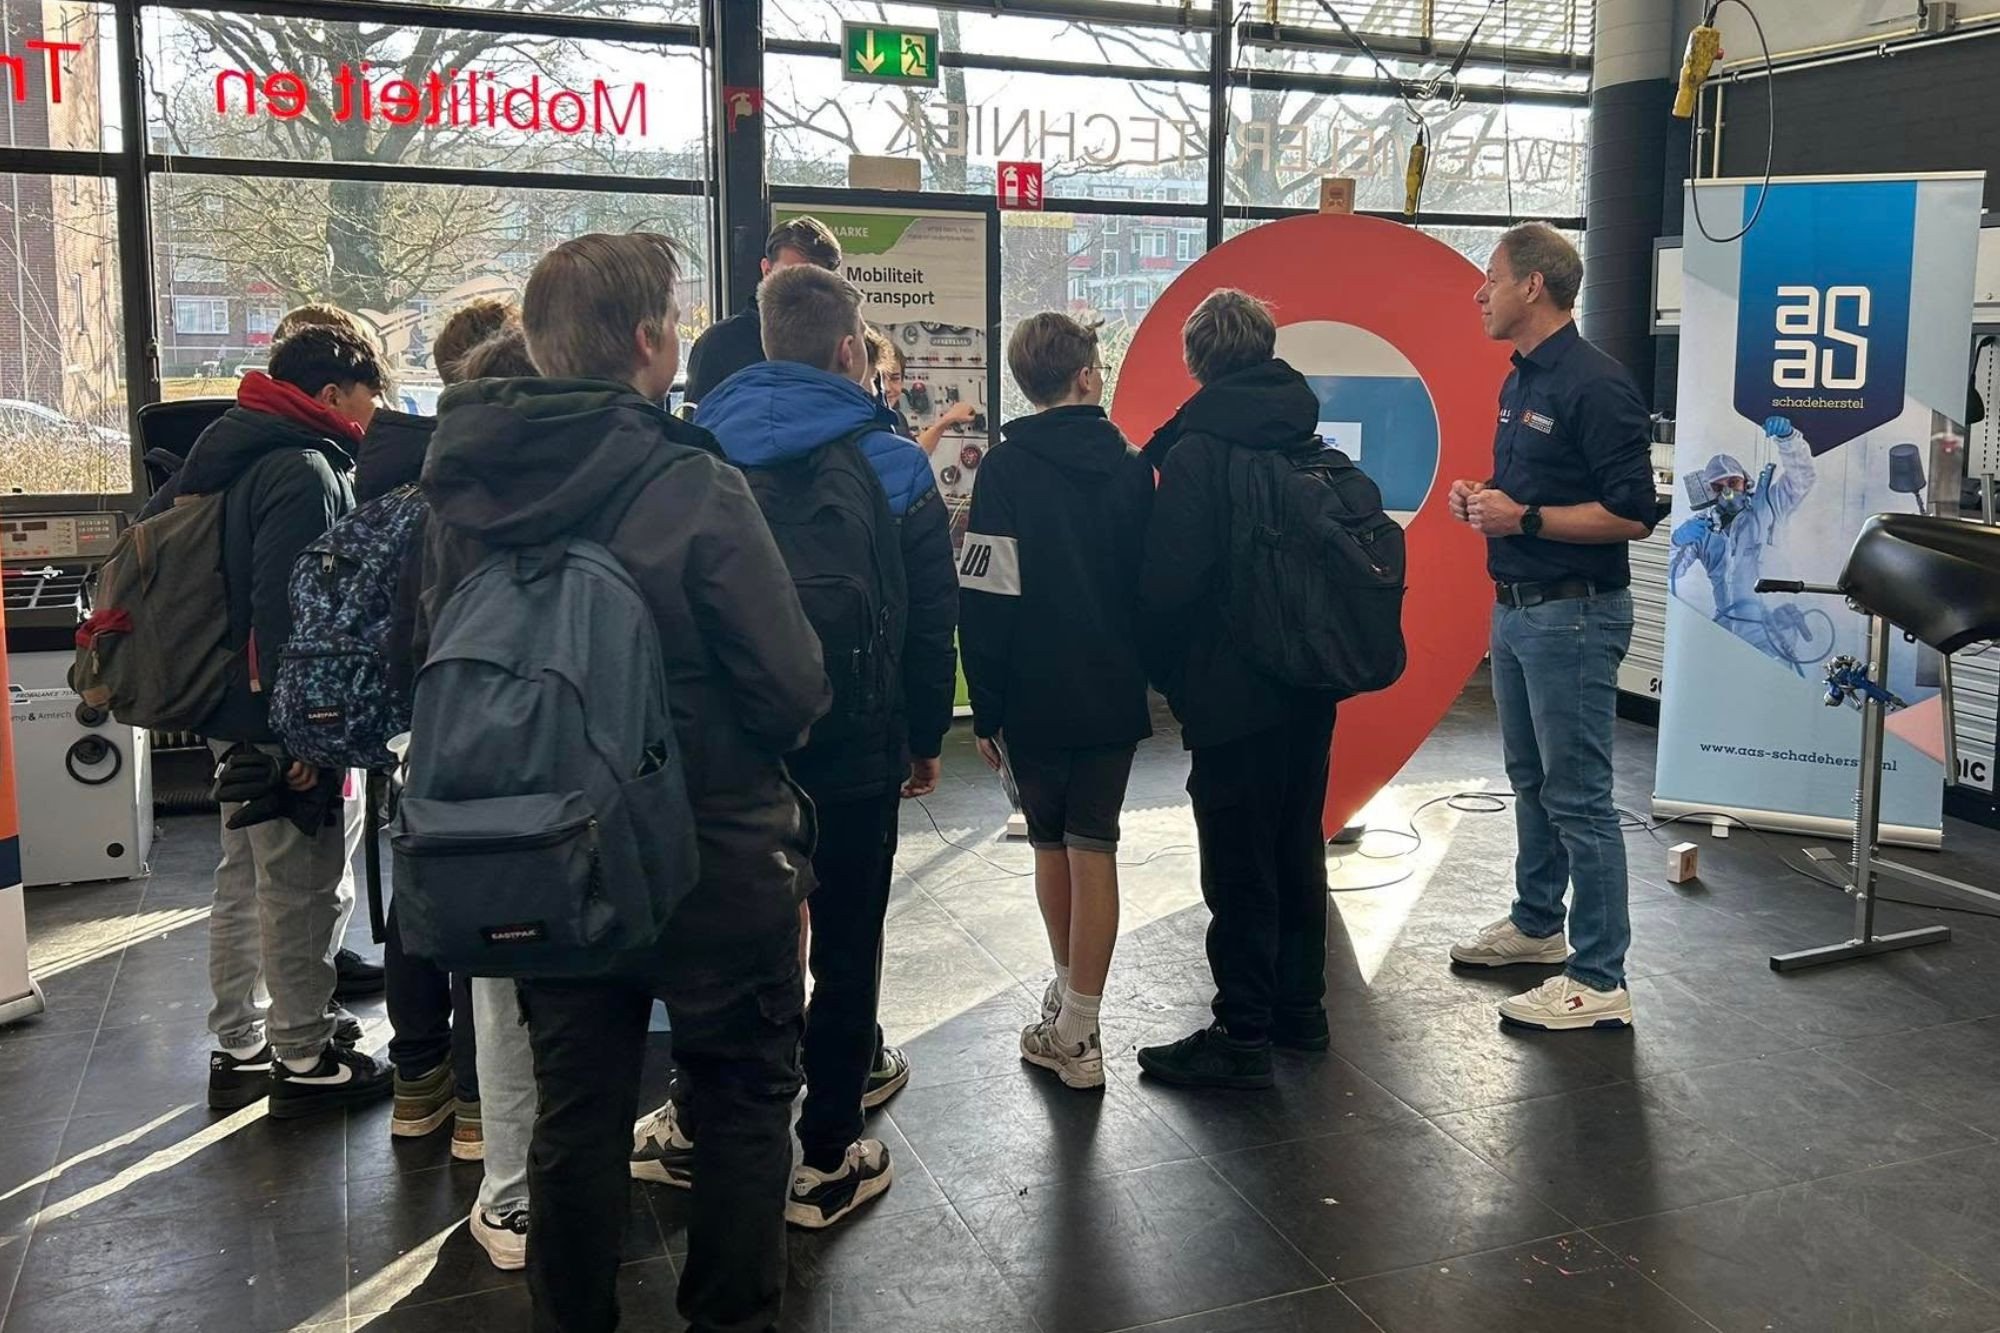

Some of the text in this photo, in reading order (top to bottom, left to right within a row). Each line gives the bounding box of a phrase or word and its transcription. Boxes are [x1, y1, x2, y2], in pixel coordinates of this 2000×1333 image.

[846, 266, 923, 284] Mobiliteit
[860, 289, 935, 308] ransport
[1772, 396, 1865, 410] schadeherstel
[491, 929, 537, 940] EASTPAK
